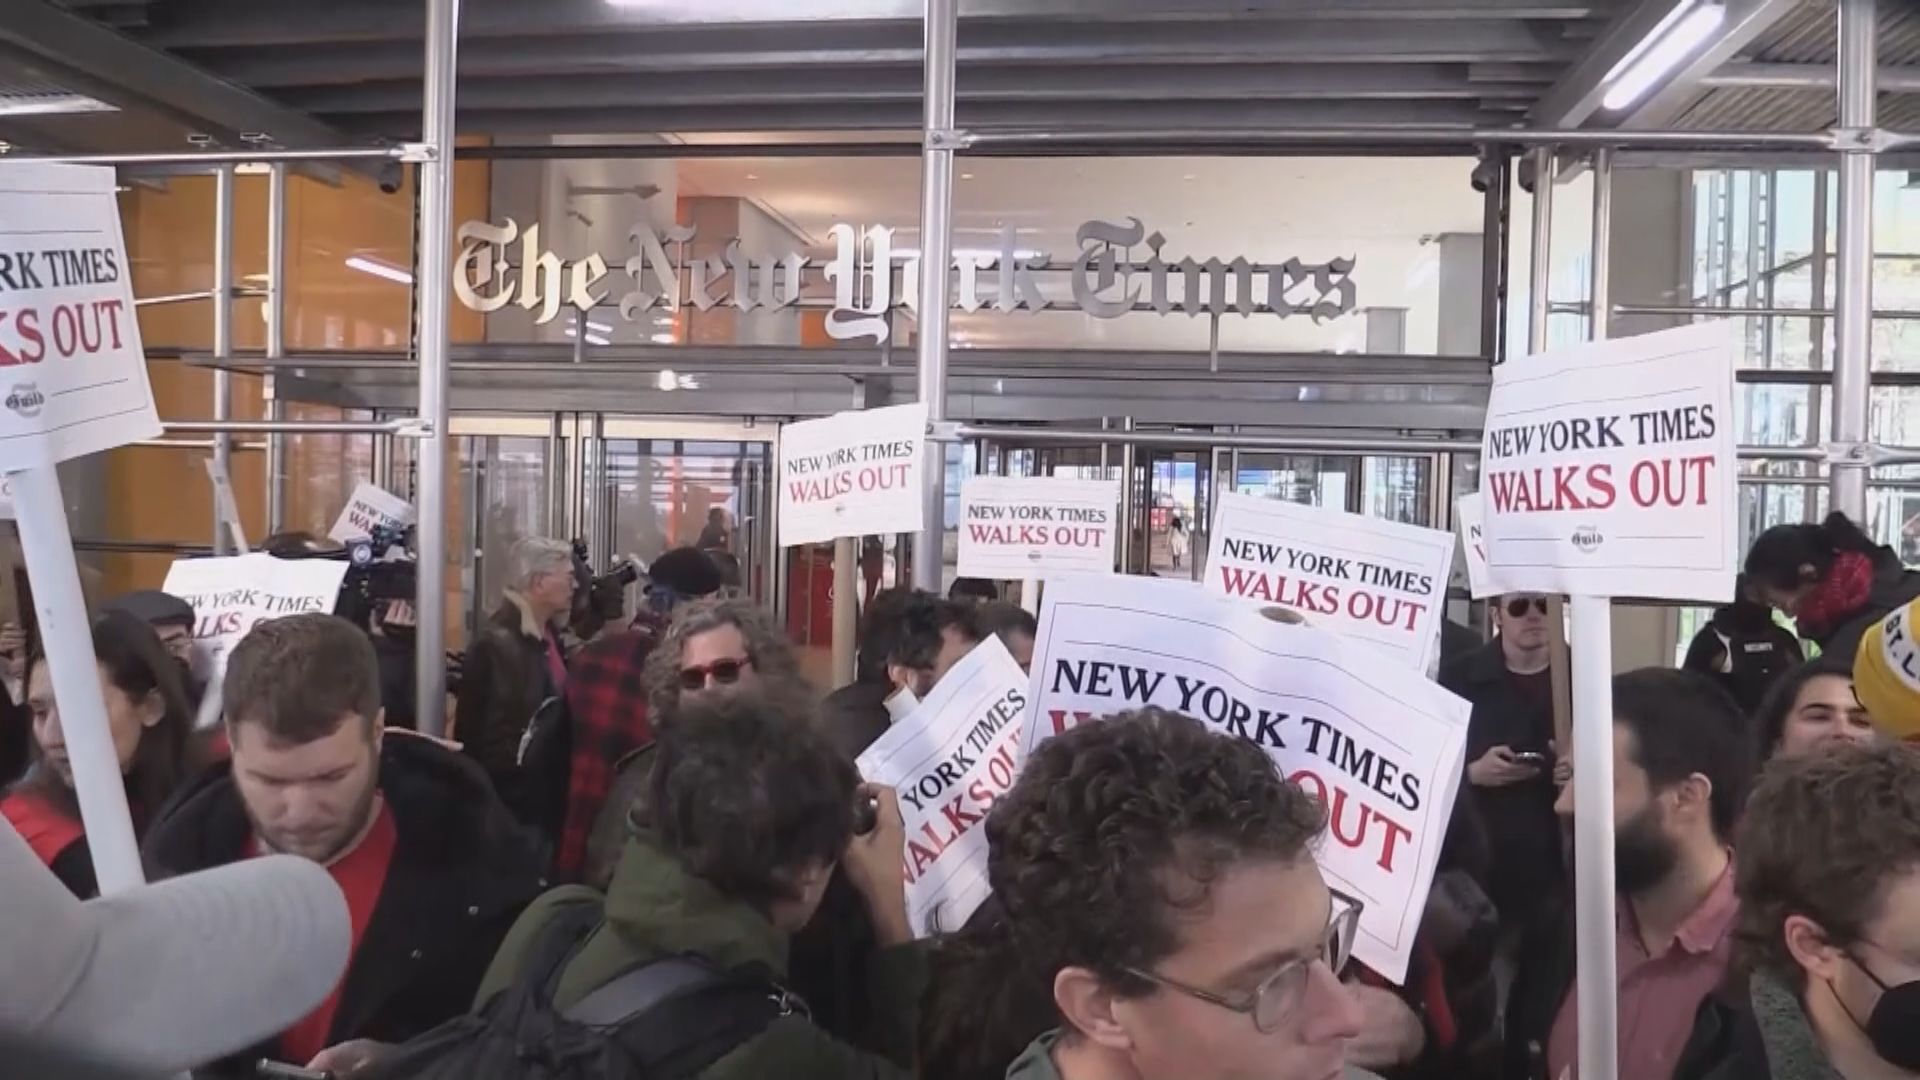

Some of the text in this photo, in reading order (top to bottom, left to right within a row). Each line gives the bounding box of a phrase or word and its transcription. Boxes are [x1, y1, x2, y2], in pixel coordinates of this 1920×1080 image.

[42, 247, 118, 288] TIMES
[452, 217, 610, 325] The
[619, 223, 811, 322] New
[1072, 216, 1356, 327] Times
[53, 299, 123, 358] OUT
[787, 440, 914, 476] NEW YORK TIMES
[1489, 403, 1716, 460] NEW YORK TIMES
[788, 463, 912, 504] WALKS OUT
[1488, 455, 1716, 515] WALKS OUT
[968, 504, 1107, 524] NEW YORK TIMES
[968, 523, 1107, 548] WALKS OUT
[1222, 537, 1433, 596] NEW YORK TIMES
[264, 593, 325, 612] TIMES
[1220, 565, 1428, 632] WALKS OUT
[902, 687, 1027, 812] YORK TIMES
[1050, 657, 1421, 814] NEW YORK TIMES
